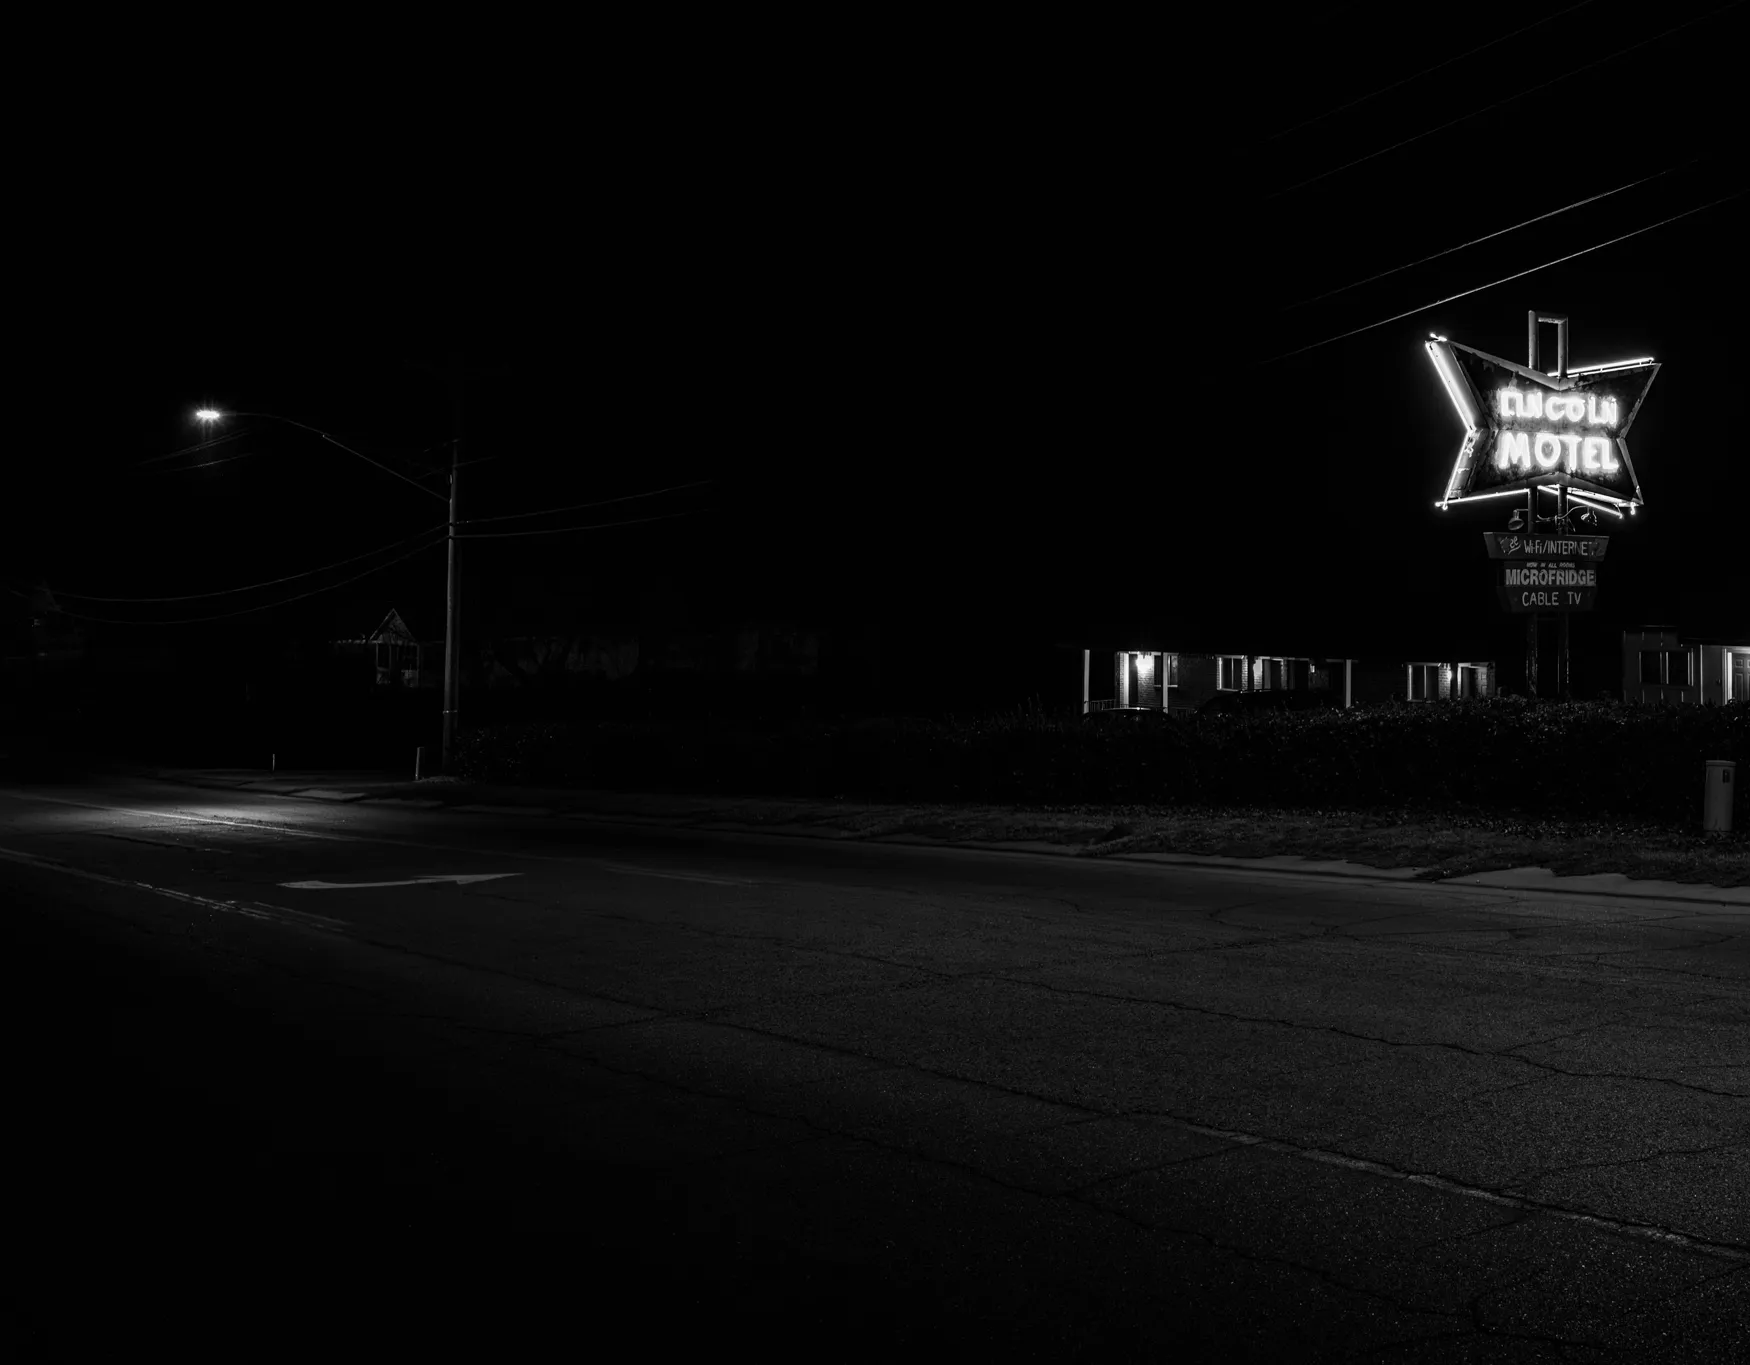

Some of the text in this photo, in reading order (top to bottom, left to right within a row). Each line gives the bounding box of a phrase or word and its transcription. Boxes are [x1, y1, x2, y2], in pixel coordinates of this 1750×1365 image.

[1501, 391, 1618, 424] LINCOLN
[1498, 431, 1619, 471] MOTEL
[1505, 568, 1596, 586] MICROFRIDGE
[1522, 591, 1582, 606] CABLE TV
